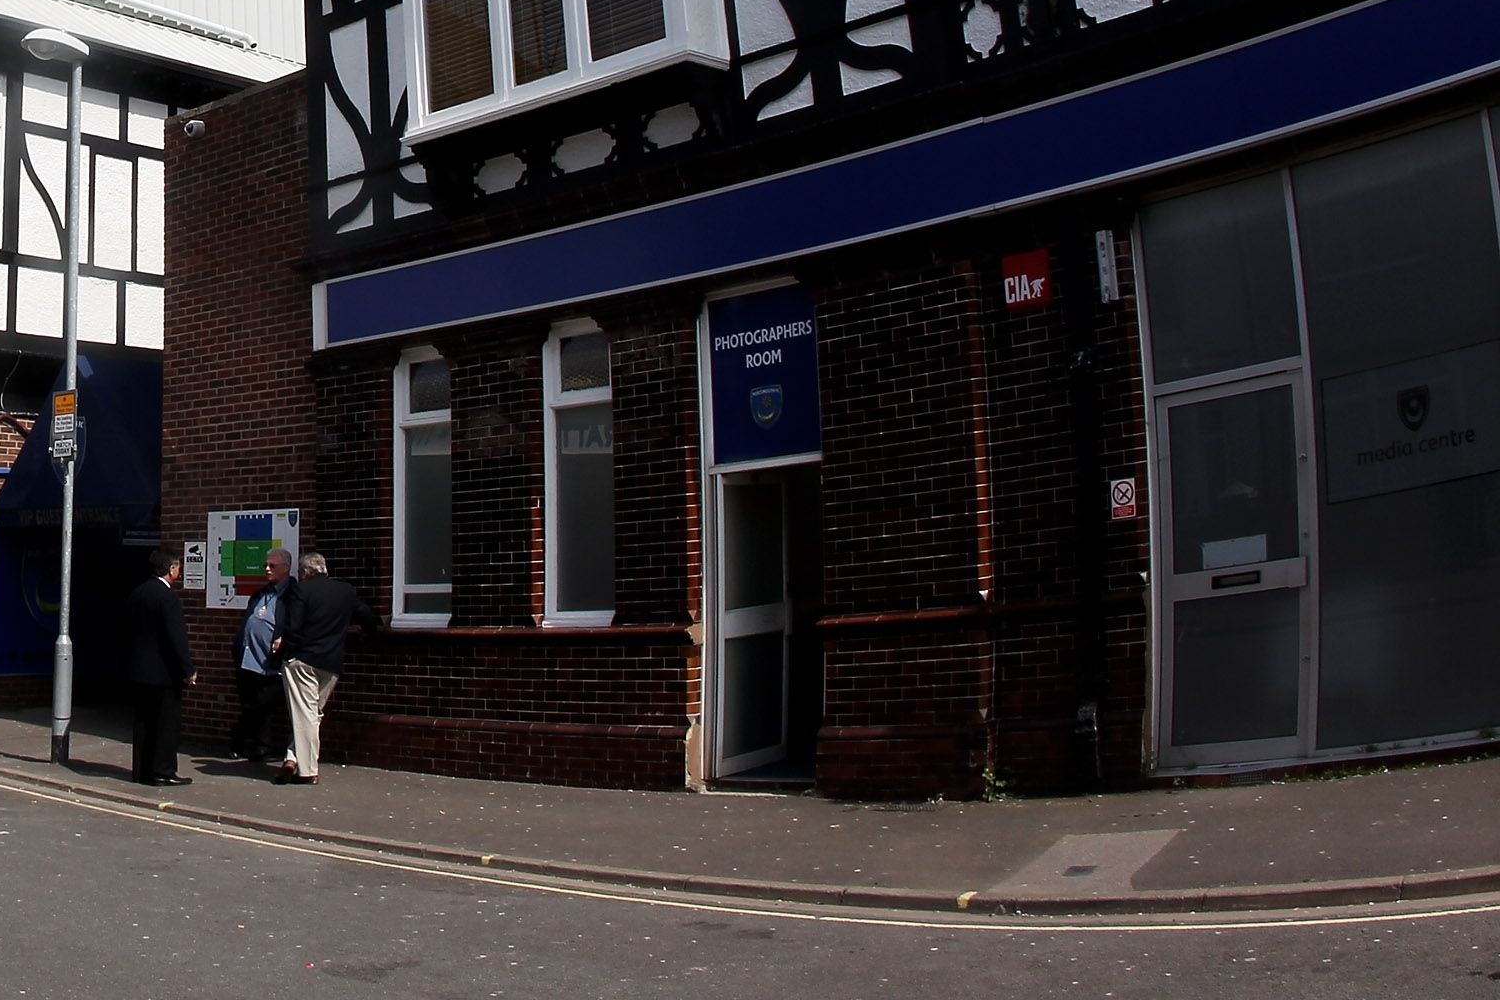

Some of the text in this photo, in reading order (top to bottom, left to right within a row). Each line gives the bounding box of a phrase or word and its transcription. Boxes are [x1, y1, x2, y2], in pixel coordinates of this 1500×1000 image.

[1004, 274, 1031, 304] CIA
[714, 319, 813, 351] PHOTOGRAPHERS
[746, 348, 782, 369] ROOM
[1357, 428, 1477, 466] media centre
